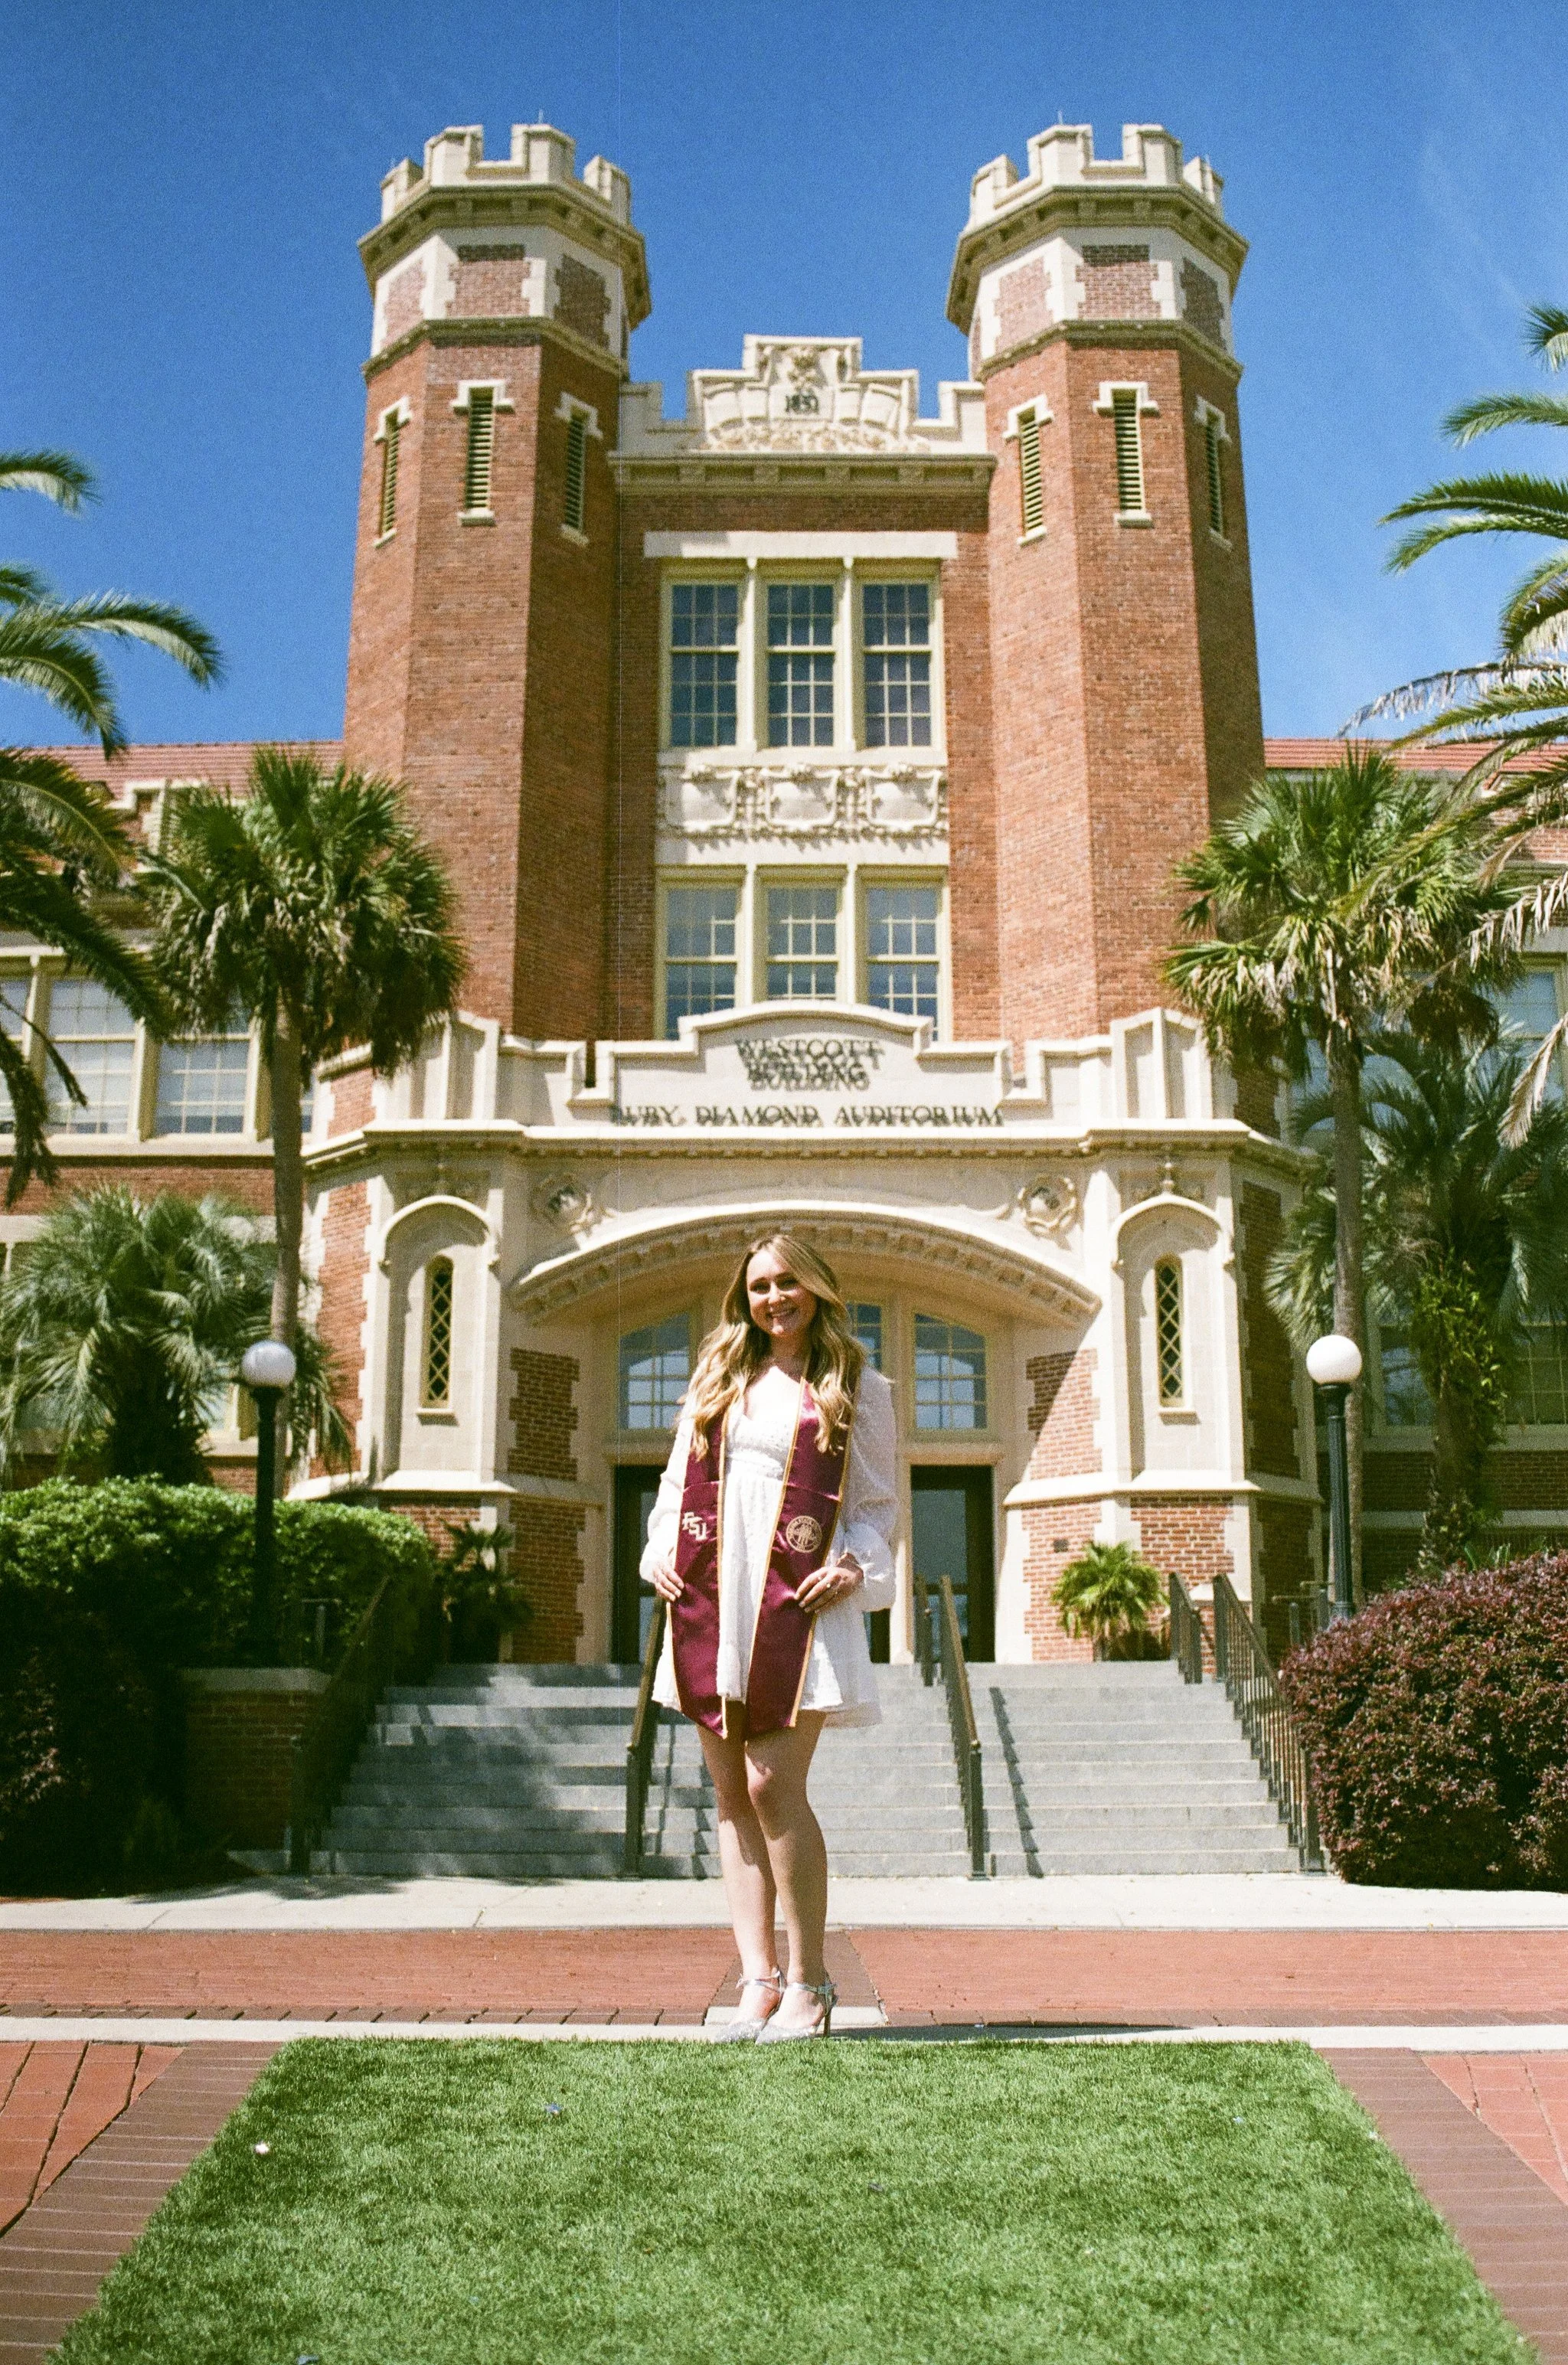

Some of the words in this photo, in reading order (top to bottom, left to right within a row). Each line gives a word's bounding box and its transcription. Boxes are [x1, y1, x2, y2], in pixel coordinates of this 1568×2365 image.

[735, 1038, 883, 1061] WESTCOTT
[694, 1105, 823, 1126] DIAMOND
[835, 1105, 1004, 1126] AUDITORIUM
[681, 1511, 707, 1541] FSU
